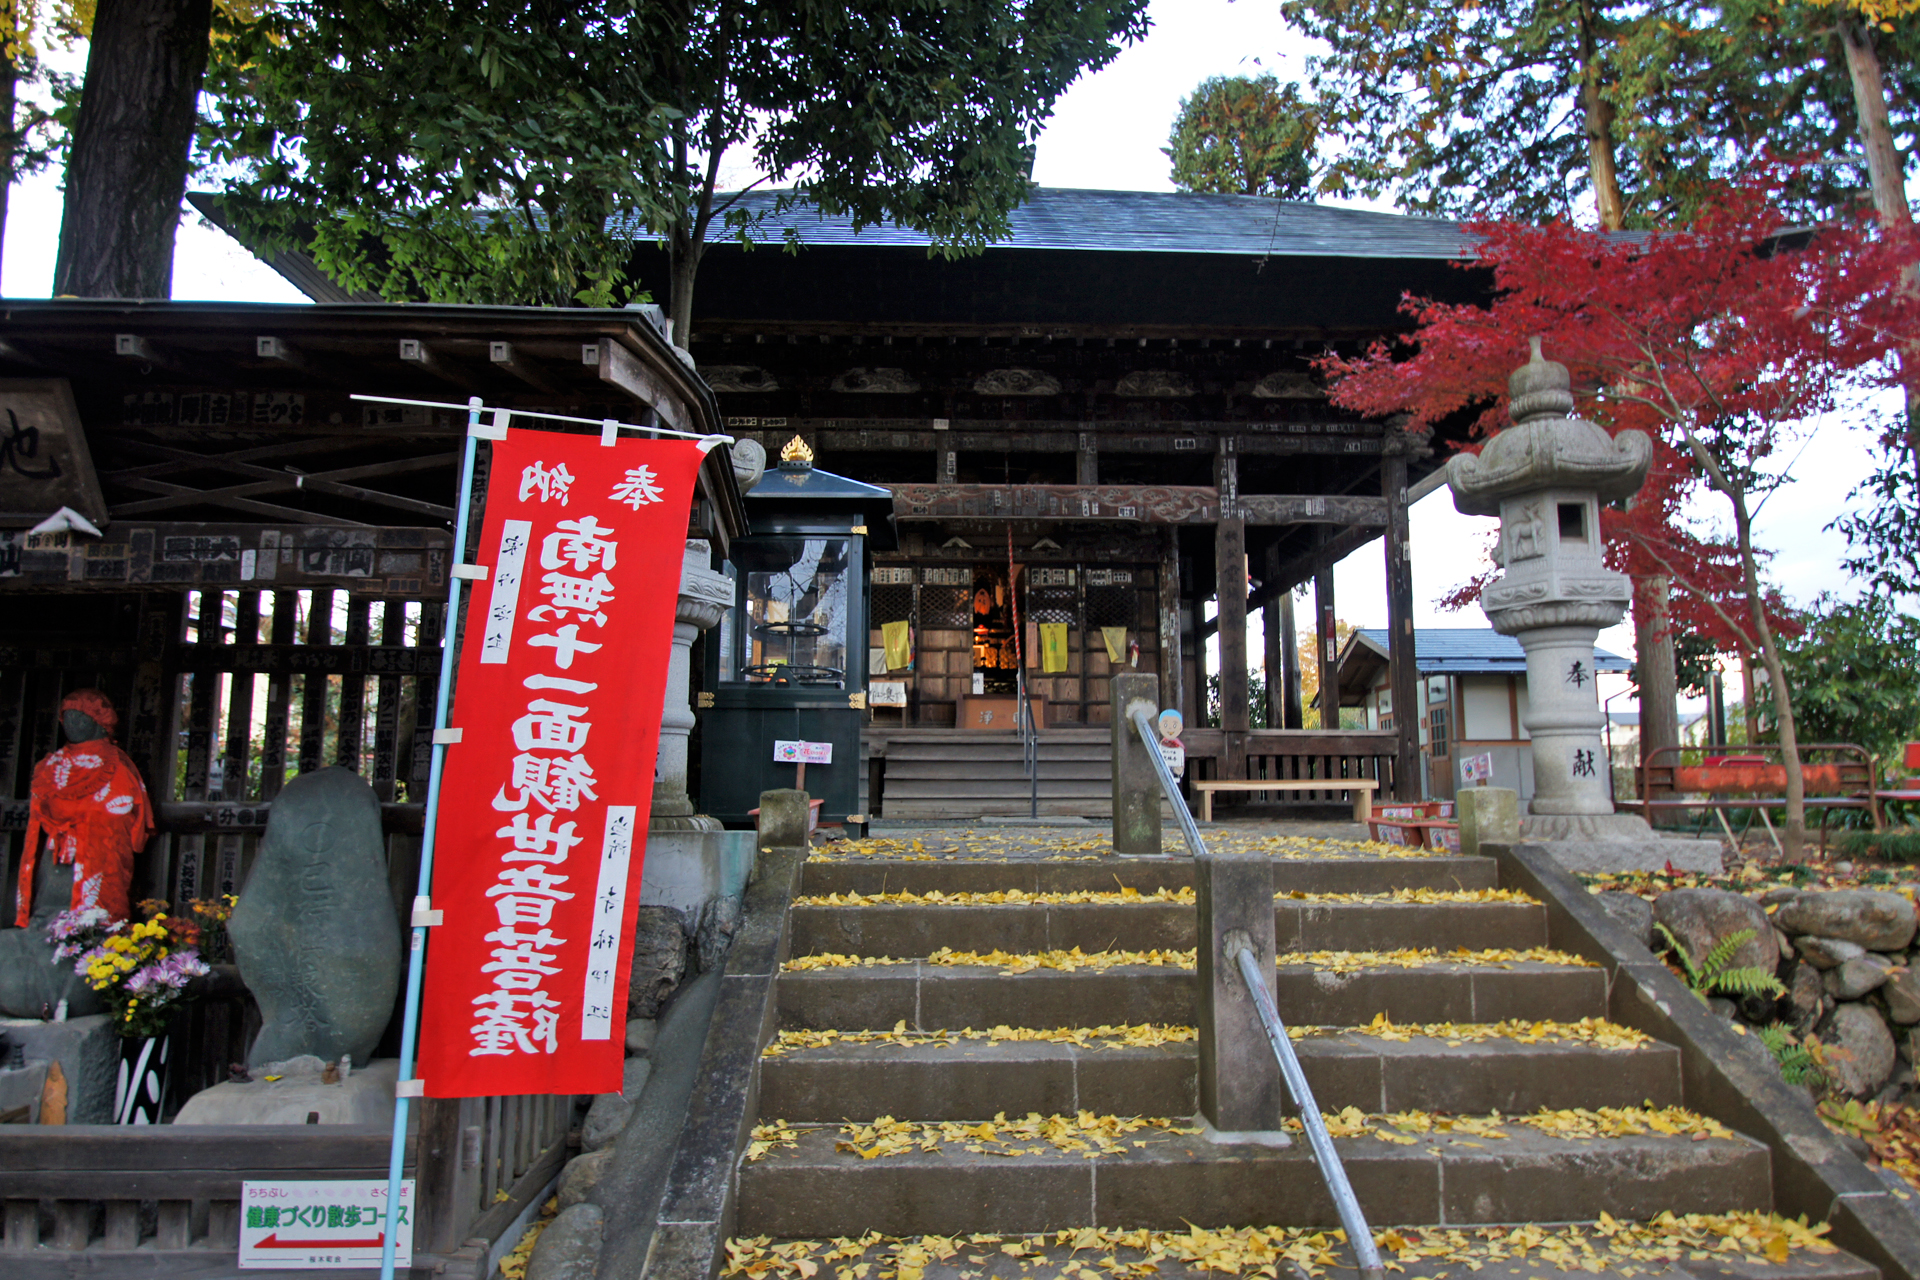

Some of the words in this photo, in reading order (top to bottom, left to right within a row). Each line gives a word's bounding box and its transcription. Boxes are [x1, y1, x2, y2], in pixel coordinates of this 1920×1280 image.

[248, 1186, 290, 1198] ちちぶし
[370, 1186, 409, 1198] さくぎ
[246, 1204, 409, 1229] 健康づくり散歩コース
[308, 1255, 342, 1264] 桜木町会
